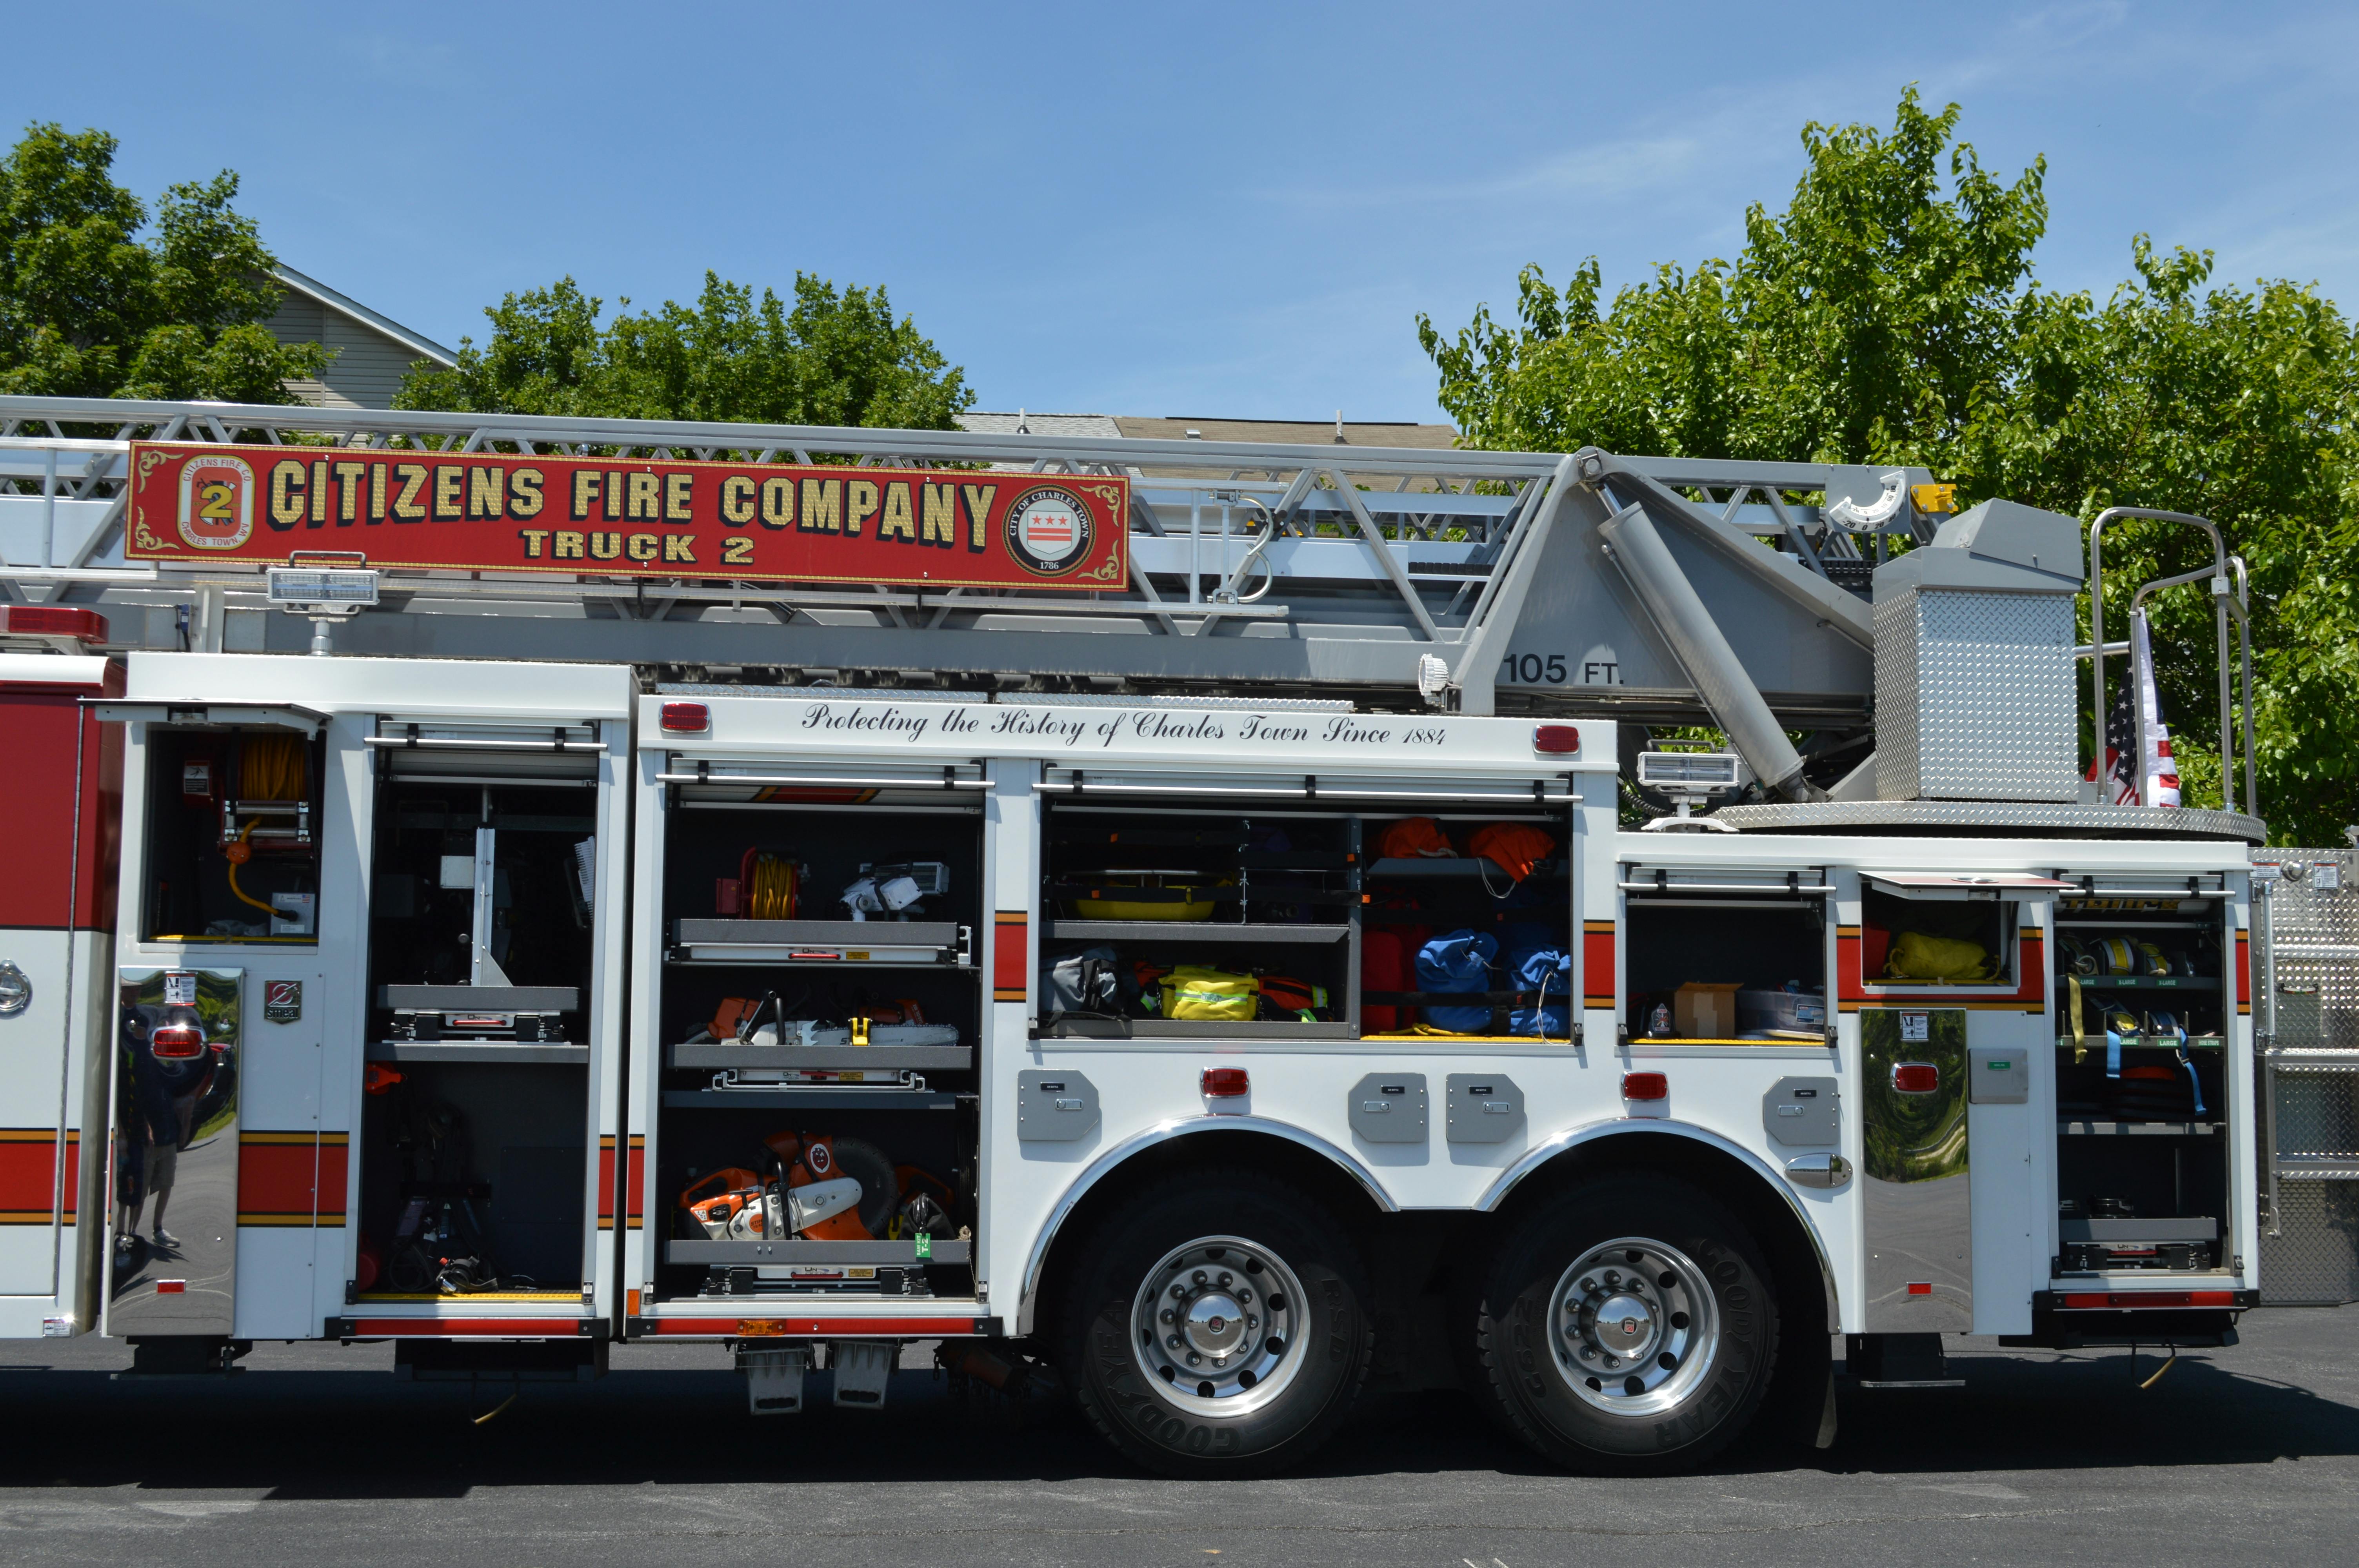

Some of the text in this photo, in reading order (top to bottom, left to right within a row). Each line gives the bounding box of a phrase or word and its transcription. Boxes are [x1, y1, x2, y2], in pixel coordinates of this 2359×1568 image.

[184, 459, 251, 483] CITIZENS FIRE CO.
[200, 485, 233, 519] 2
[267, 459, 997, 553] CITIZENS FIRE COMPANY
[1009, 491, 1089, 538] CITY OF CHARLES TOWN
[182, 521, 249, 546] CHARLES TOWN, WV
[1842, 519, 1856, 529] -20
[1874, 521, 1884, 530] 20
[519, 529, 755, 565] TRUCK 2
[1040, 561, 1059, 570] 1786
[1503, 653, 1624, 684] 105 FT.
[802, 704, 1446, 747] Protecting the History of Charles Town Since 1884
[267, 1009, 298, 1019] smeal
[1514, 1295, 1547, 1397] G622
